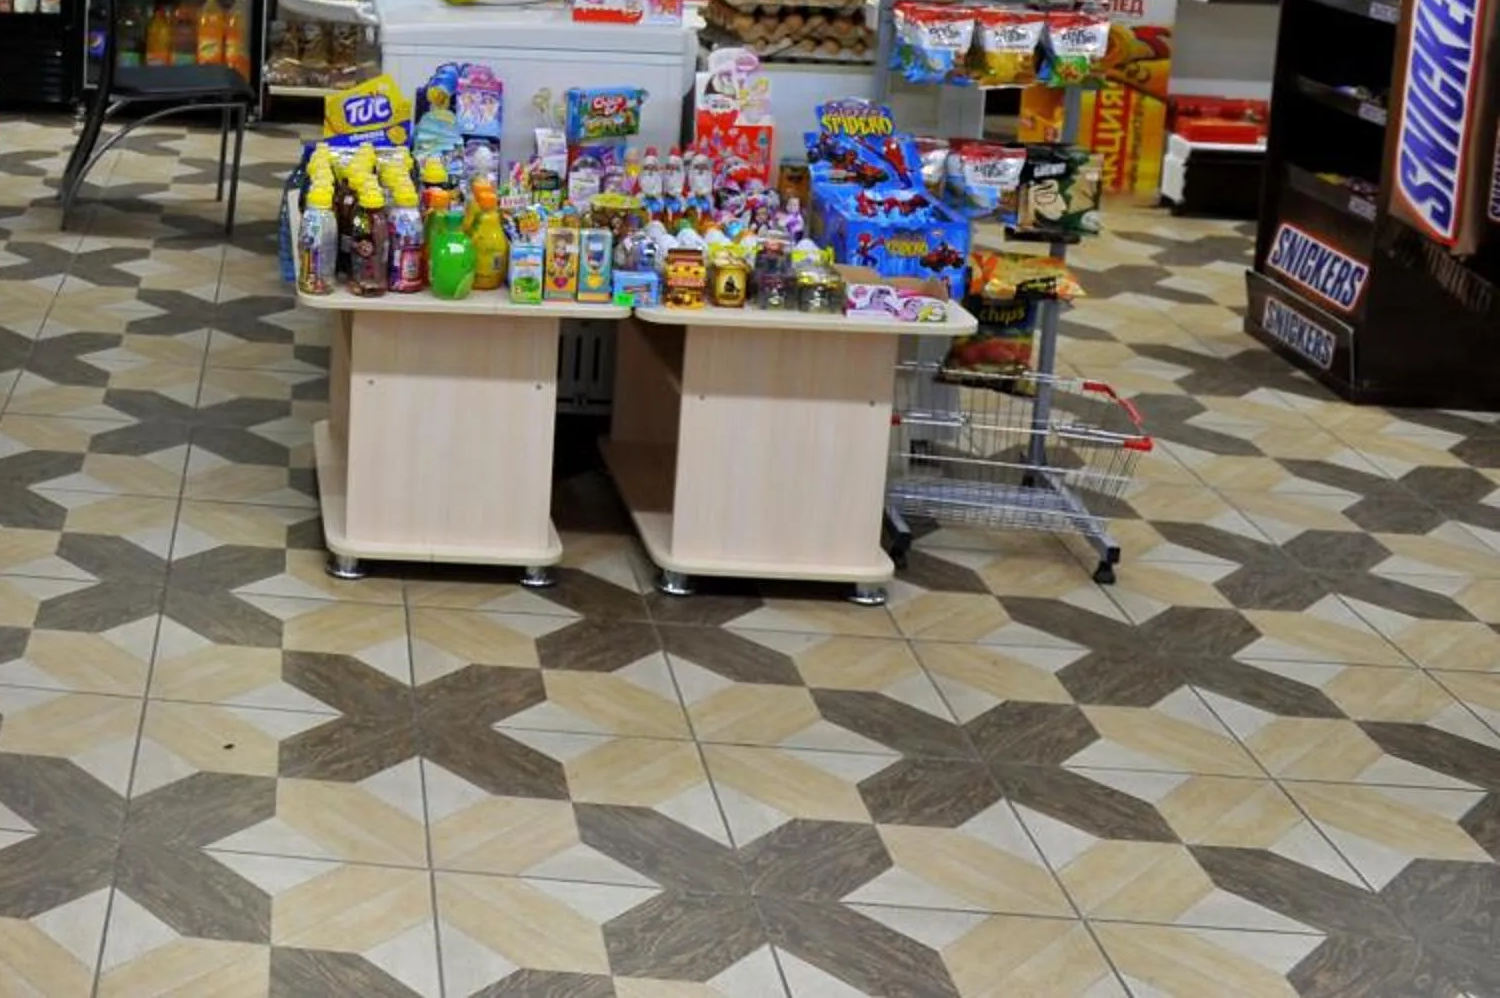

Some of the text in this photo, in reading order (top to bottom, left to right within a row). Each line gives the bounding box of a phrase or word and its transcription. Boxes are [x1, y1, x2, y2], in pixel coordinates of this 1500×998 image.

[345, 100, 392, 126] TUC
[1272, 228, 1367, 309] SNICKERS
[979, 302, 1027, 329] chips
[1264, 308, 1336, 369] SNICKERS
